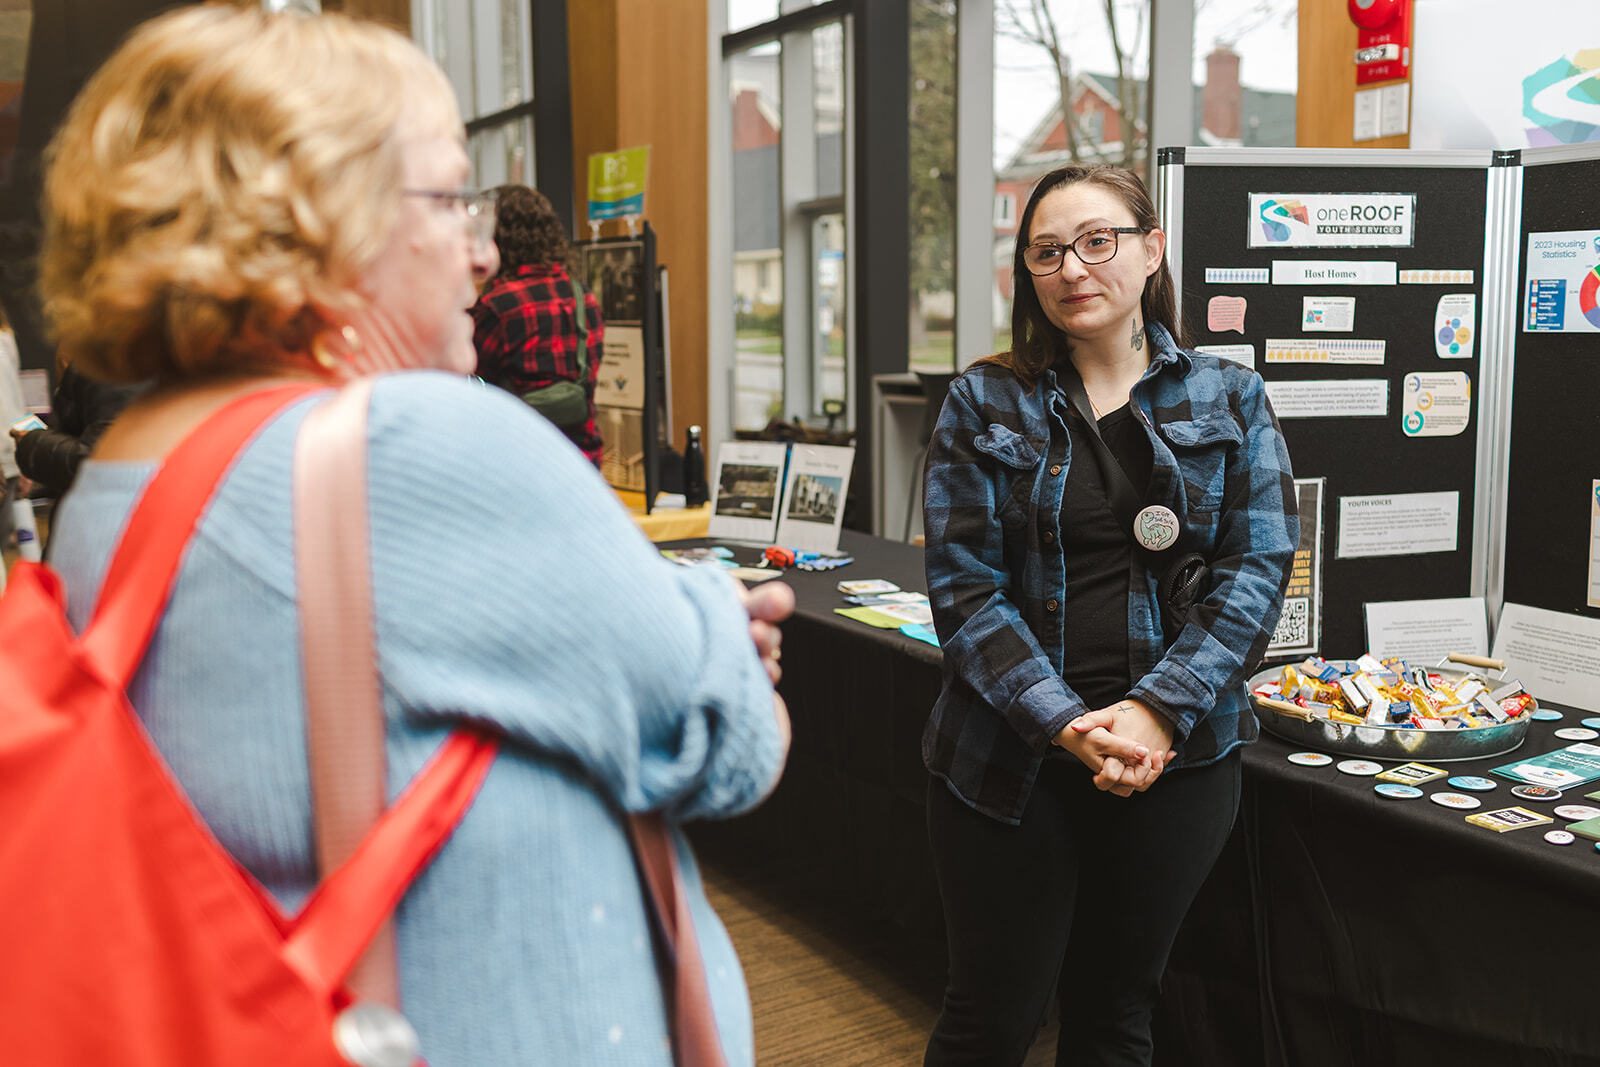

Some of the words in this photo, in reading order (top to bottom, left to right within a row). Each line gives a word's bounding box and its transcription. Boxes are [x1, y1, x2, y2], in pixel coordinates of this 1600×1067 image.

[1317, 205, 1404, 221] oneROOF
[1319, 226, 1350, 234] YOUTH
[1355, 226, 1401, 234] SERVICES
[1534, 241, 1553, 249] 2023
[1554, 240, 1586, 250] Housing
[1542, 250, 1577, 258] Statistics
[1305, 269, 1325, 278] Host
[1328, 269, 1357, 278] Homes
